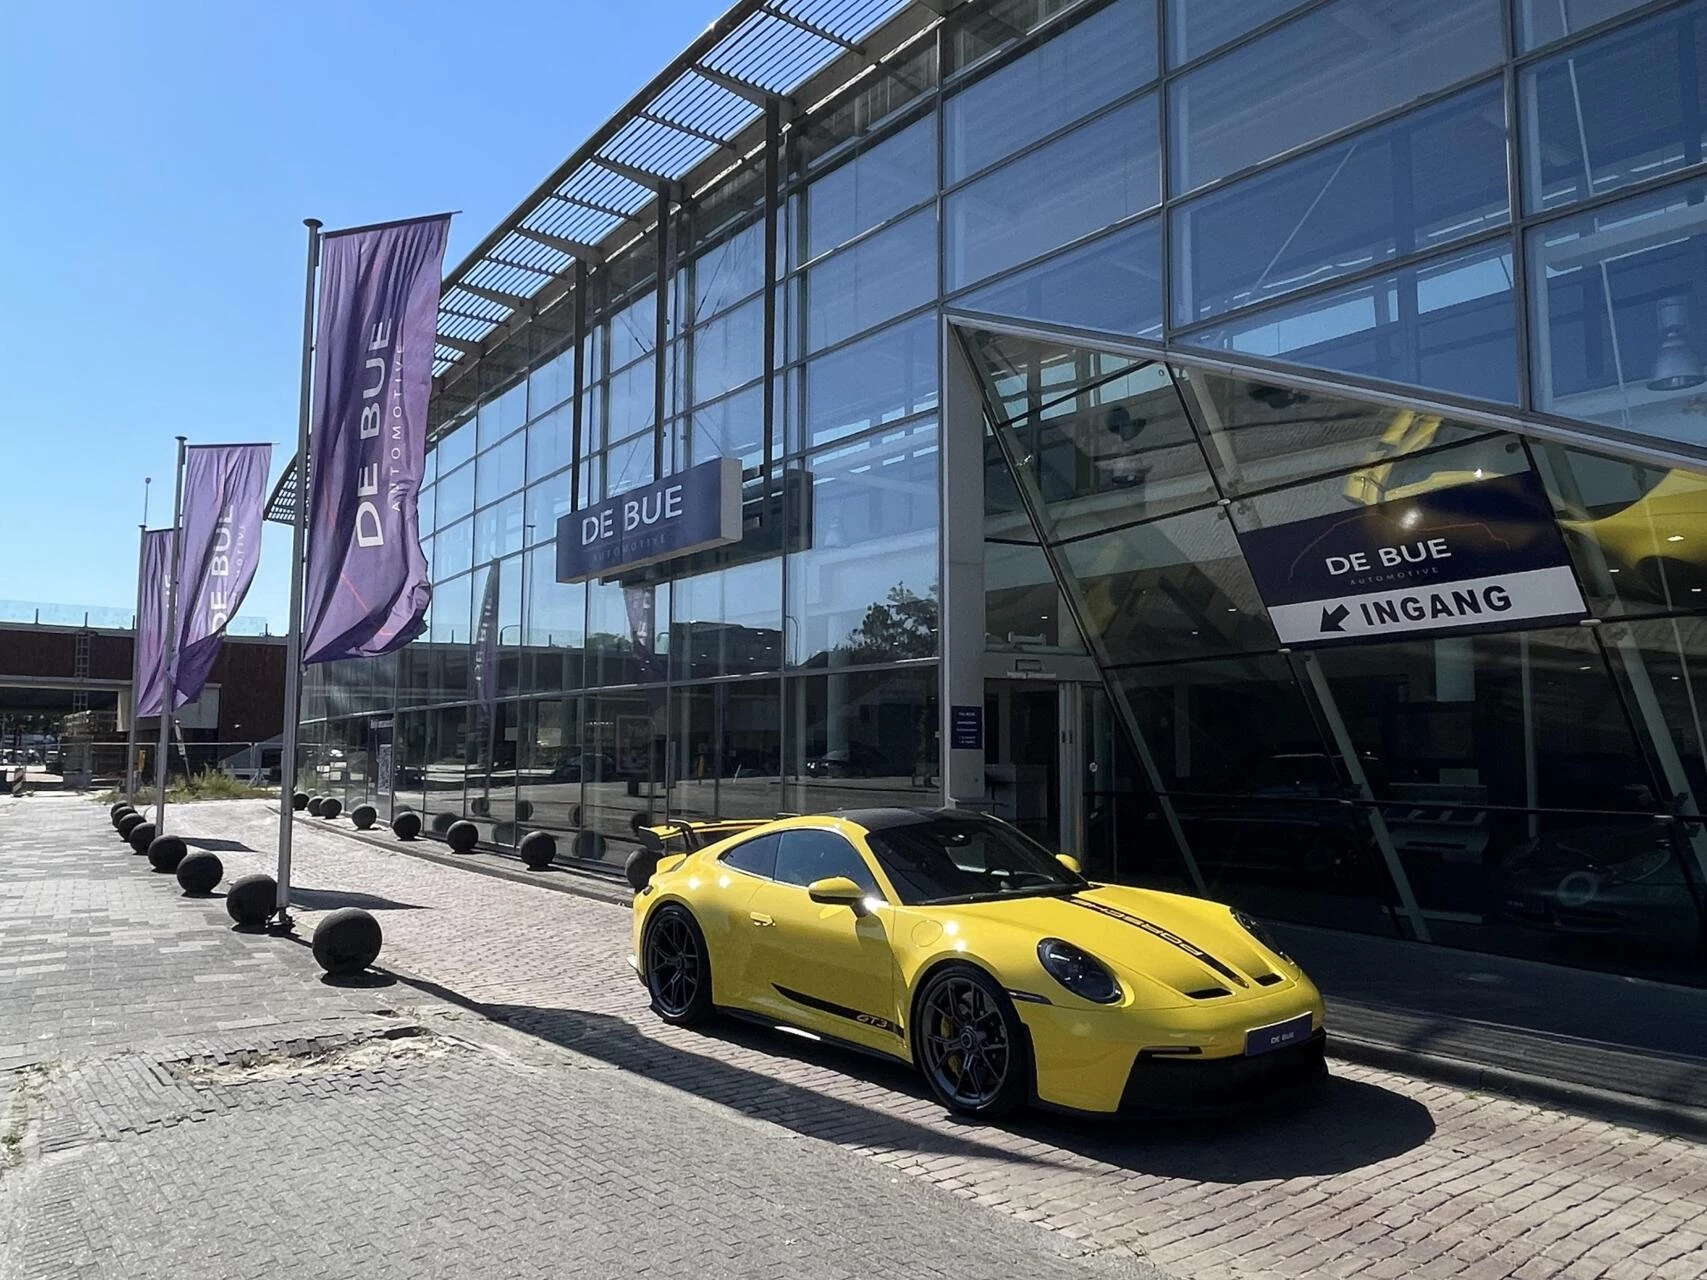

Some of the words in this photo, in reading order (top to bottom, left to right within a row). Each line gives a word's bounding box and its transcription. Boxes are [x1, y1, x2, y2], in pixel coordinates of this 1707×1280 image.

[360, 318, 392, 440] BUE
[356, 462, 385, 547] DE
[581, 508, 613, 546] DE
[624, 484, 683, 531] BUE
[1325, 552, 1370, 576] DE
[1378, 538, 1451, 567] BUE
[1350, 567, 1439, 585] AUTOMOTIVE
[1360, 585, 1513, 626] INGANG
[856, 1014, 888, 1028] GT3
